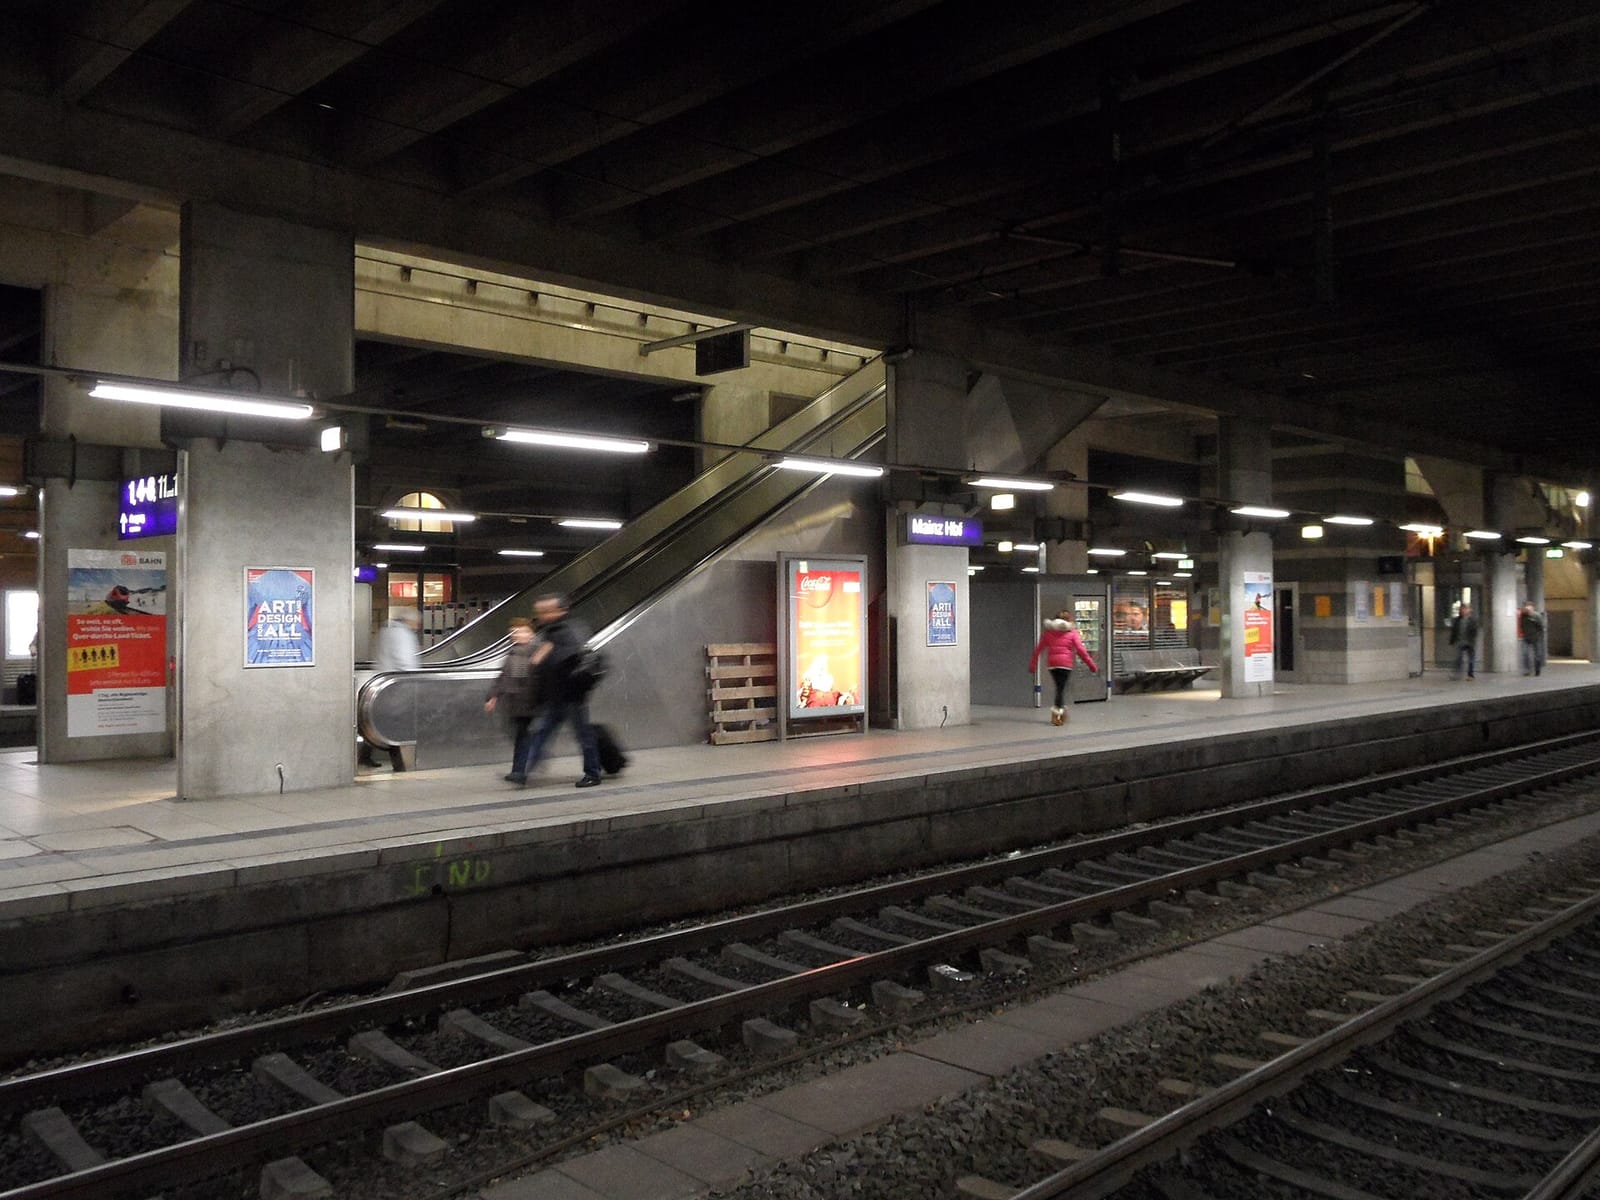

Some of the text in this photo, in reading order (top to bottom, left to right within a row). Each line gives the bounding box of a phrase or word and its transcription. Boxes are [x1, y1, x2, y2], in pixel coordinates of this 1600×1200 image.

[912, 518, 963, 537] Mainz Hbf
[258, 600, 295, 613] ART
[257, 614, 302, 623] DESIGN
[264, 623, 302, 637] ALL
